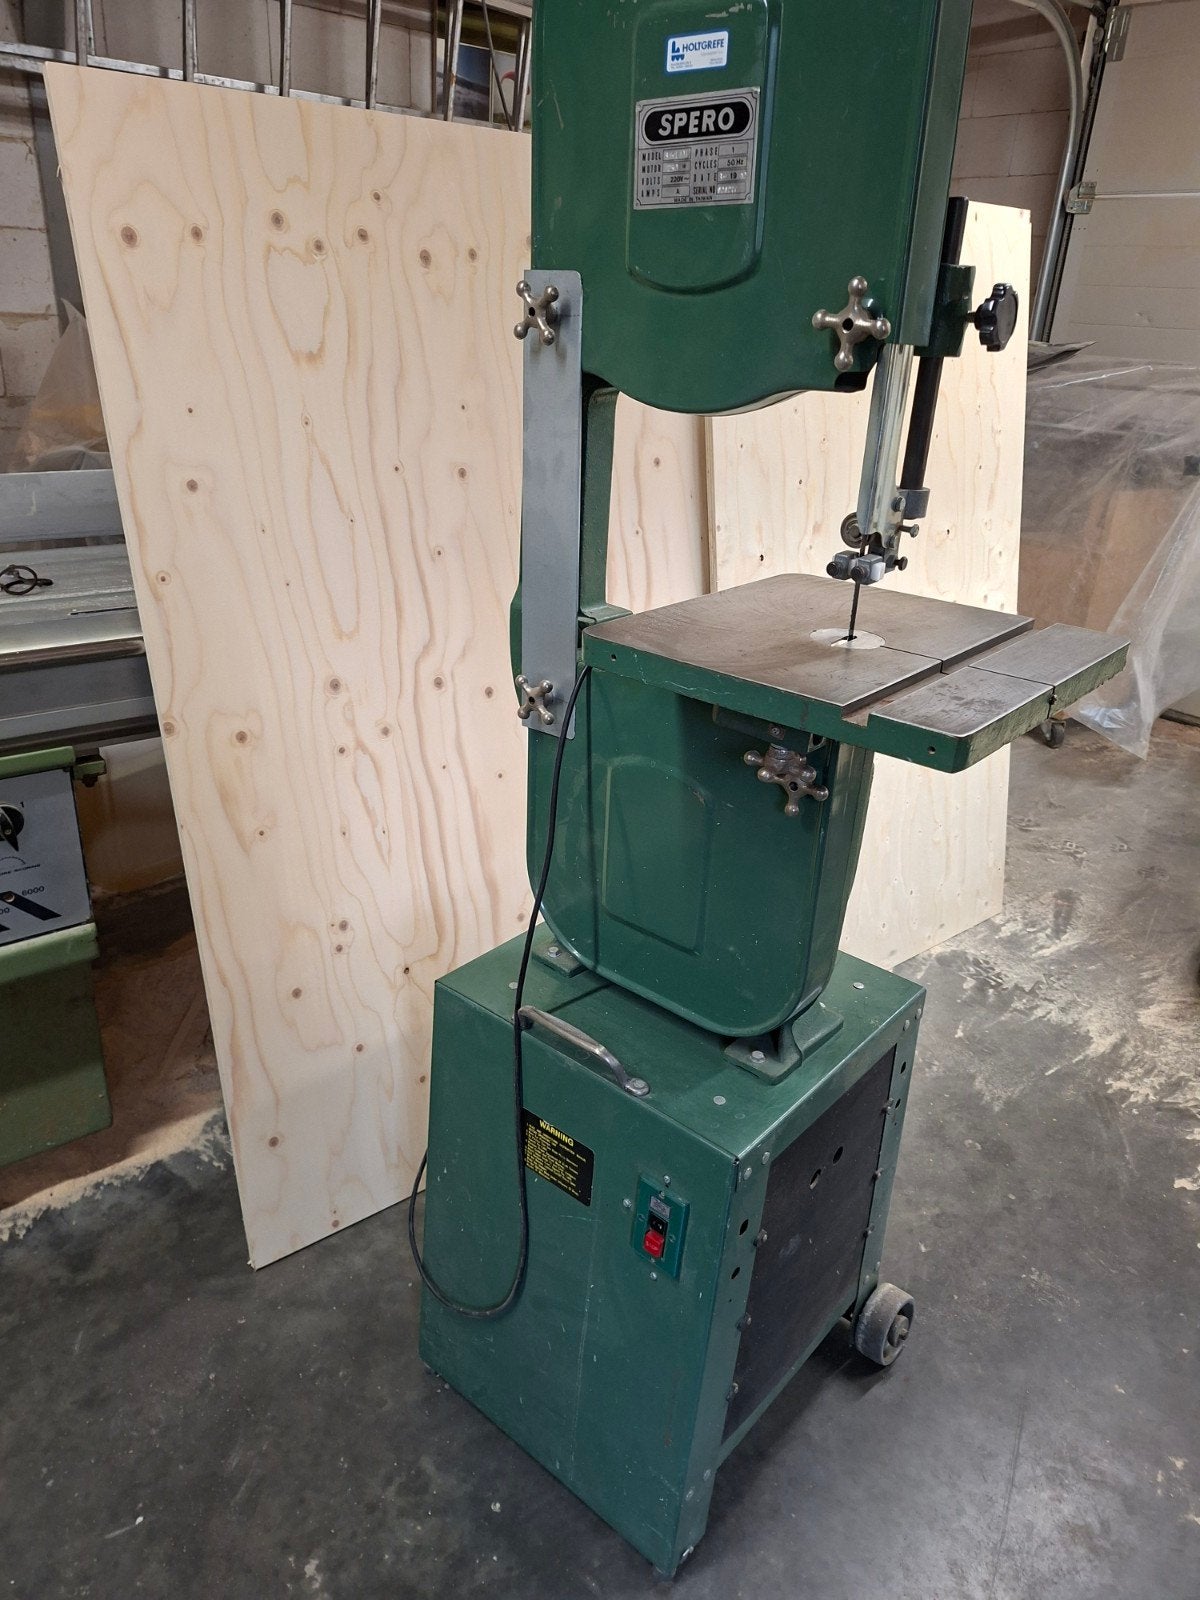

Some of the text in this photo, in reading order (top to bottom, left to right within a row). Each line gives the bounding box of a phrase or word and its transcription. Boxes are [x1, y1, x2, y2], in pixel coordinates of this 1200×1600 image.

[682, 38, 725, 52] HOLTGREFE
[658, 106, 735, 136] SPERO
[642, 151, 661, 161] MODEL
[695, 146, 718, 157] PHASE
[642, 164, 661, 173] MOTOR
[694, 159, 717, 169] CYCLES
[641, 176, 660, 186] VOLTS
[694, 172, 717, 182] DATE
[641, 188, 660, 198] AMPS
[22, 885, 45, 896] 6000
[539, 1119, 574, 1147] WARNING
